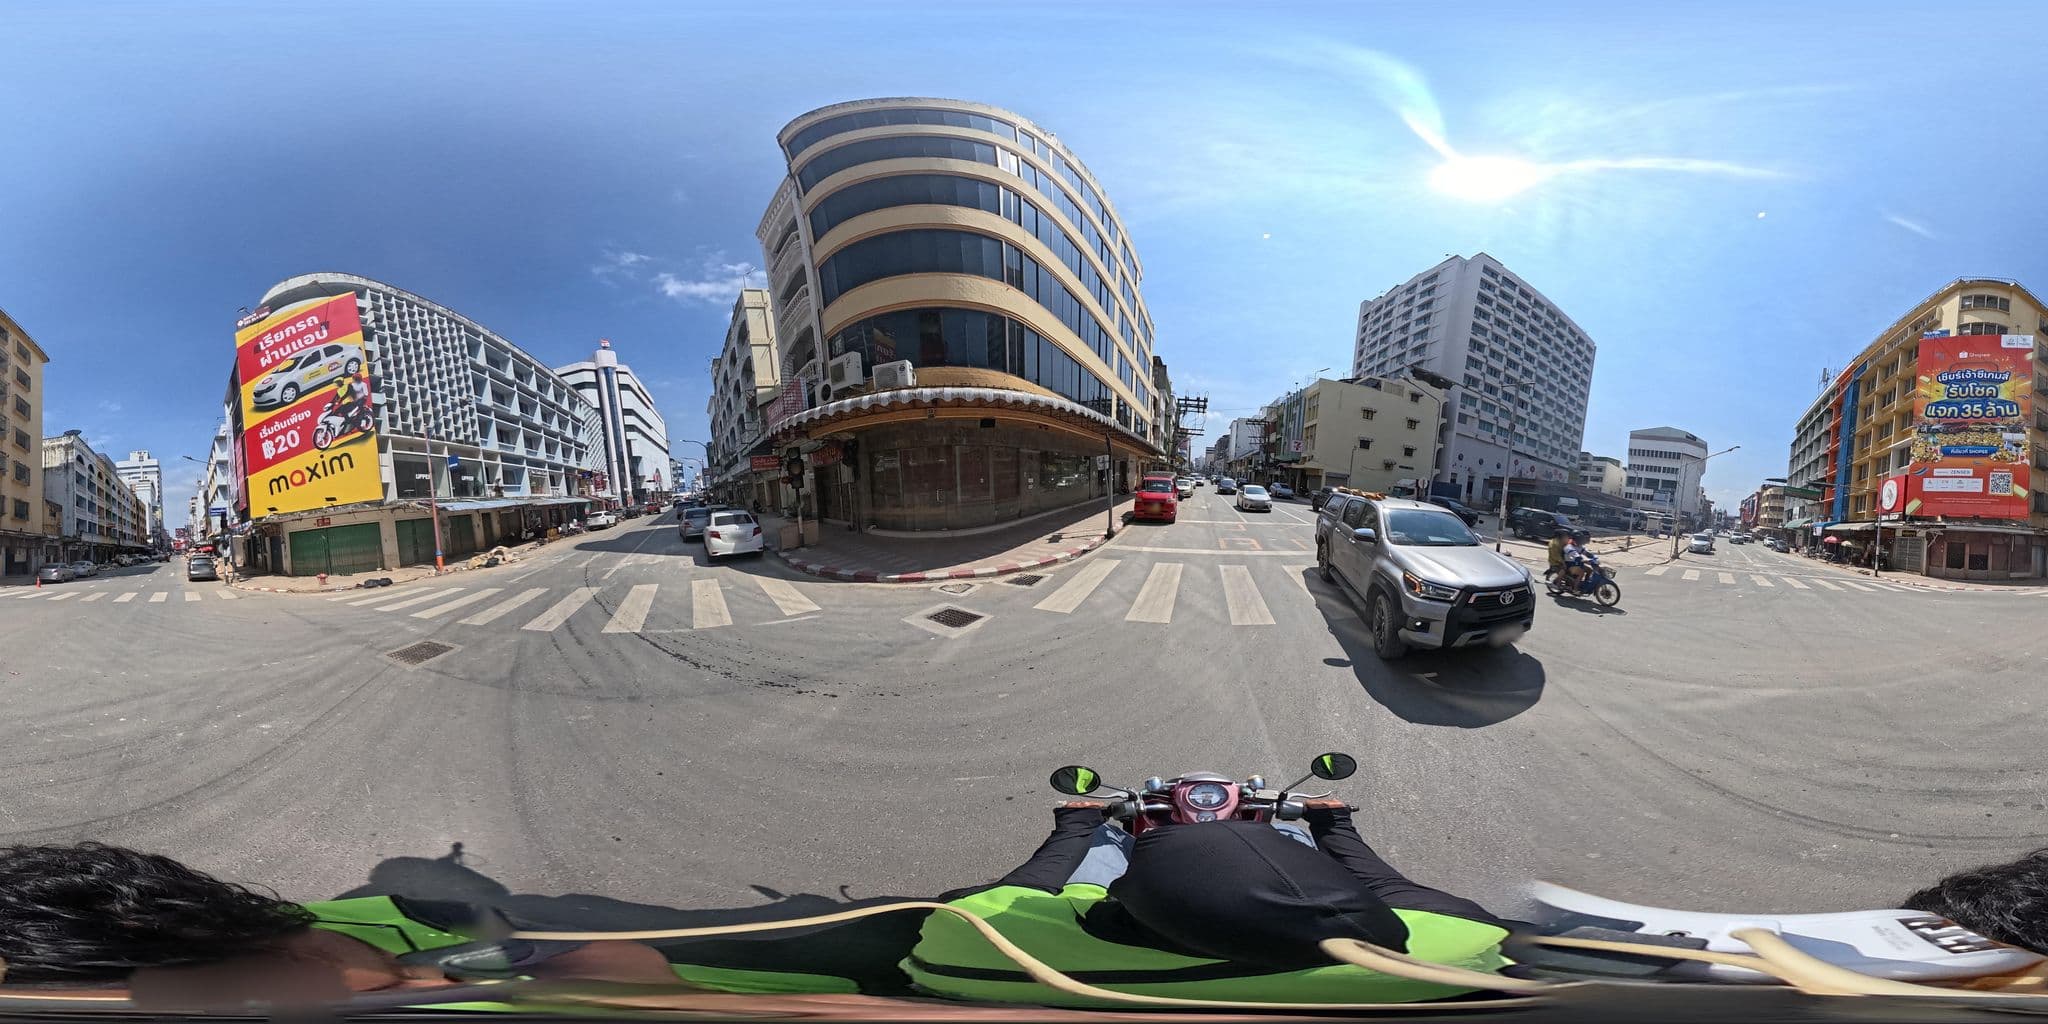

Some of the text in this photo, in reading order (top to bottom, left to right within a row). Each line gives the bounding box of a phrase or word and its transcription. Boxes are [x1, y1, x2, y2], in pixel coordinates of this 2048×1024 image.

[259, 315, 319, 350] เรียกรถ
[1948, 382, 1997, 397] รับโชค
[1926, 401, 2017, 417] แจก 35 ล้าน
[259, 410, 311, 439] เริ่มต้นเพียง
[269, 452, 354, 496] maxim
